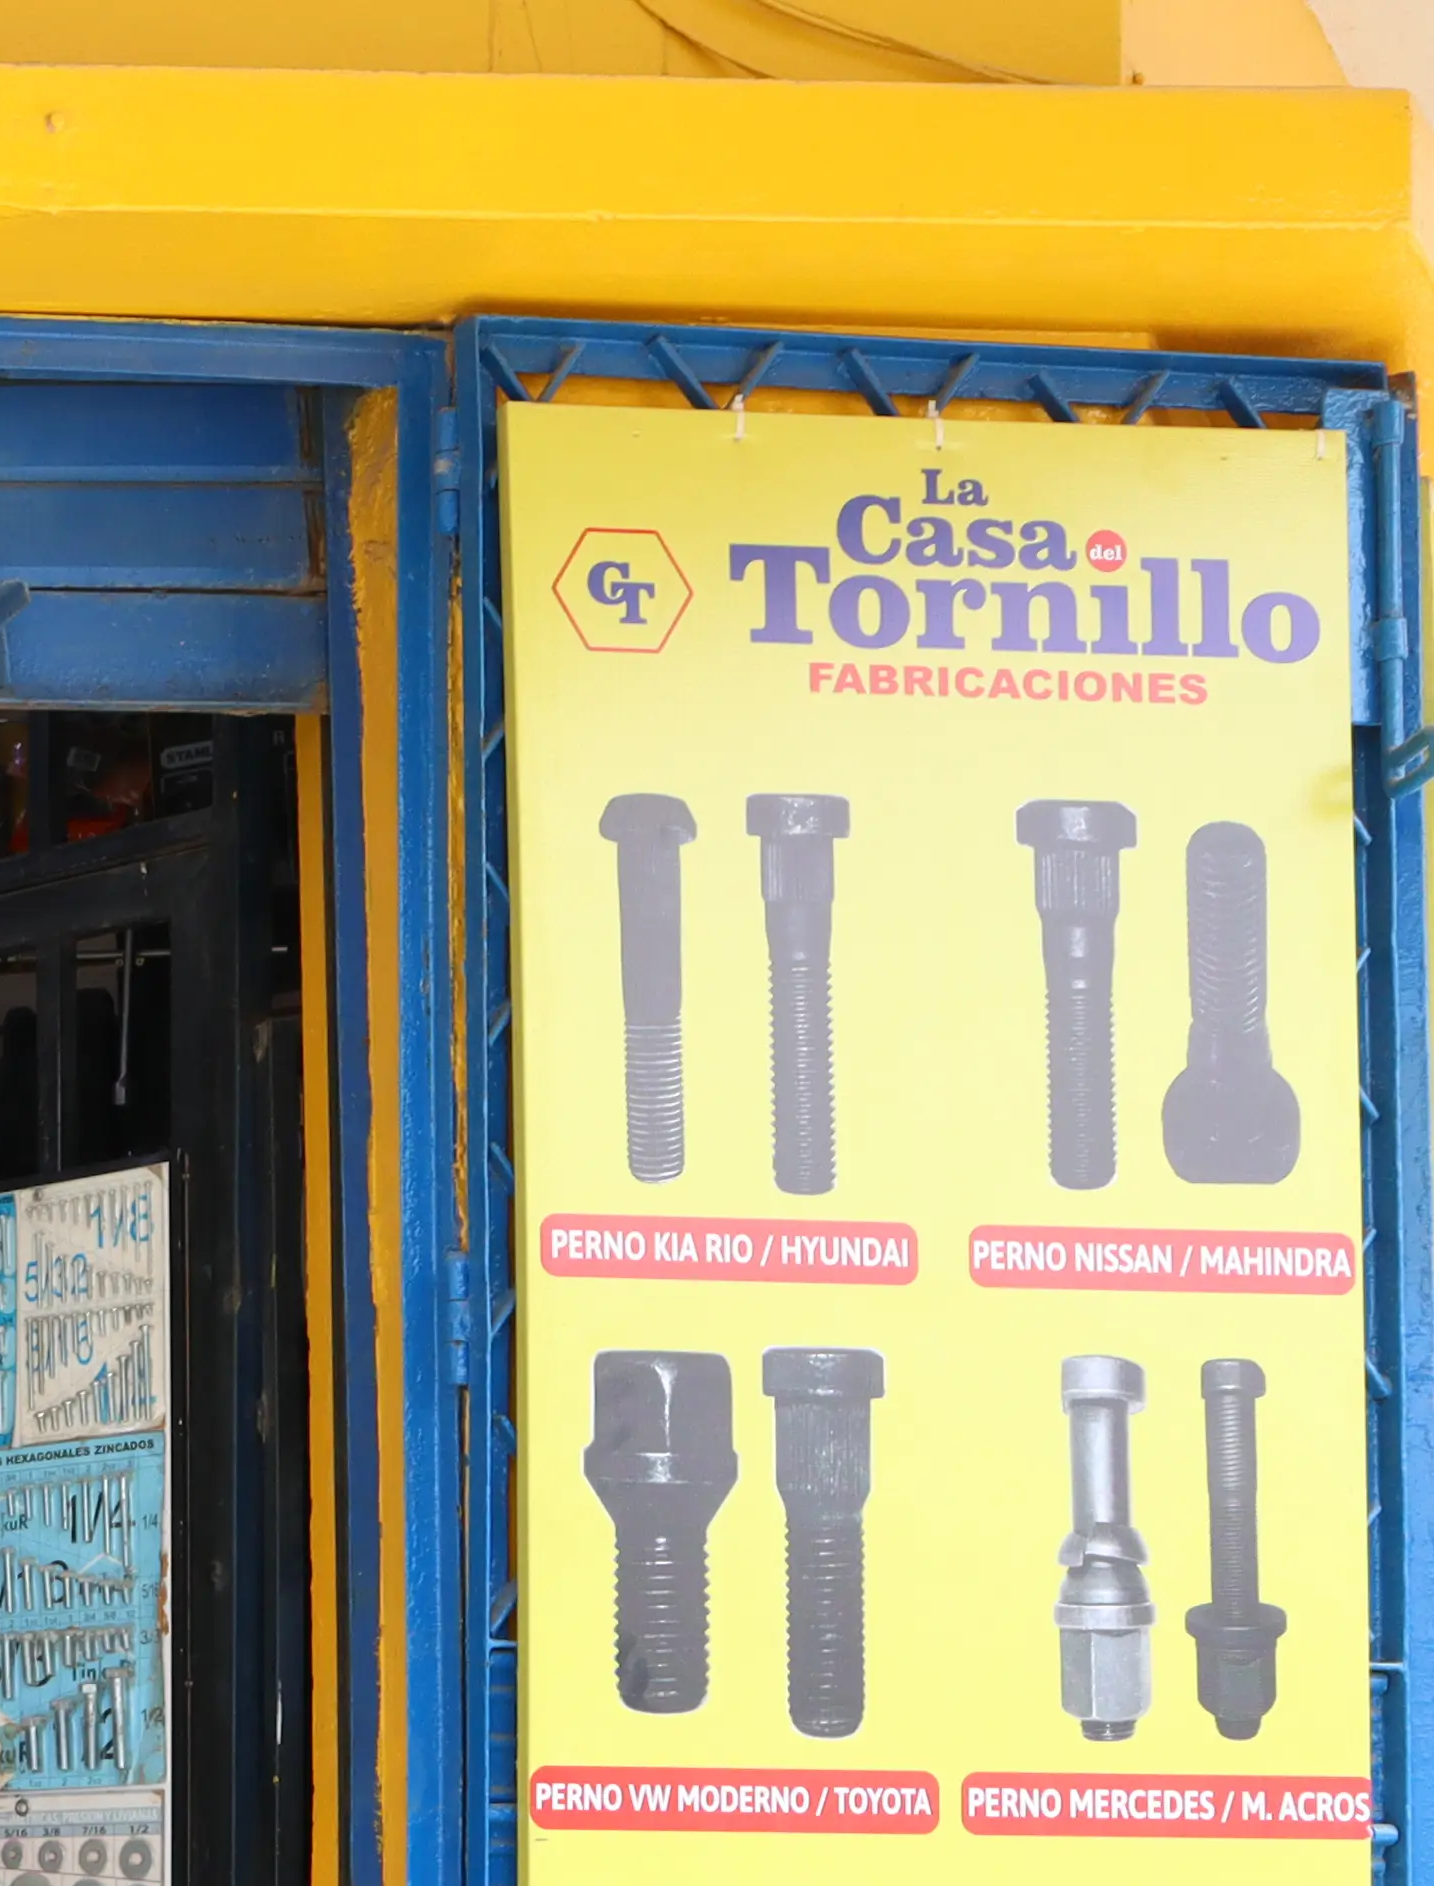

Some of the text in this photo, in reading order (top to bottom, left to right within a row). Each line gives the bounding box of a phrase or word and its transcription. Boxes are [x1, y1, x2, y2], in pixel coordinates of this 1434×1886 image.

[922, 469, 988, 506] La
[838, 495, 1078, 571] Casa
[1089, 543, 1122, 561] del
[587, 561, 655, 624] GT
[729, 544, 1322, 663] Tornillo
[811, 662, 1207, 705] FABRICACIONES
[551, 1228, 646, 1261] PERNO
[653, 1231, 699, 1263] KIA
[705, 1232, 753, 1264] RIO
[781, 1235, 909, 1268] HYUNDAI
[973, 1238, 1065, 1273] PERNO
[1074, 1240, 1174, 1275] NISSAN
[1199, 1244, 1352, 1279] MAHINDRA
[6, 1448, 90, 1465] HEXAGONALES
[94, 1441, 154, 1455] ZINCADOS
[536, 1783, 622, 1811] PERNO
[629, 1784, 671, 1811] VW
[678, 1785, 809, 1813] MODERNO
[834, 1787, 931, 1815] TOYOTA
[968, 1787, 1061, 1818] PERNO
[1070, 1789, 1215, 1820] MERCEDES
[1242, 1791, 1272, 1820] M.
[1279, 1792, 1371, 1822] ACROS
